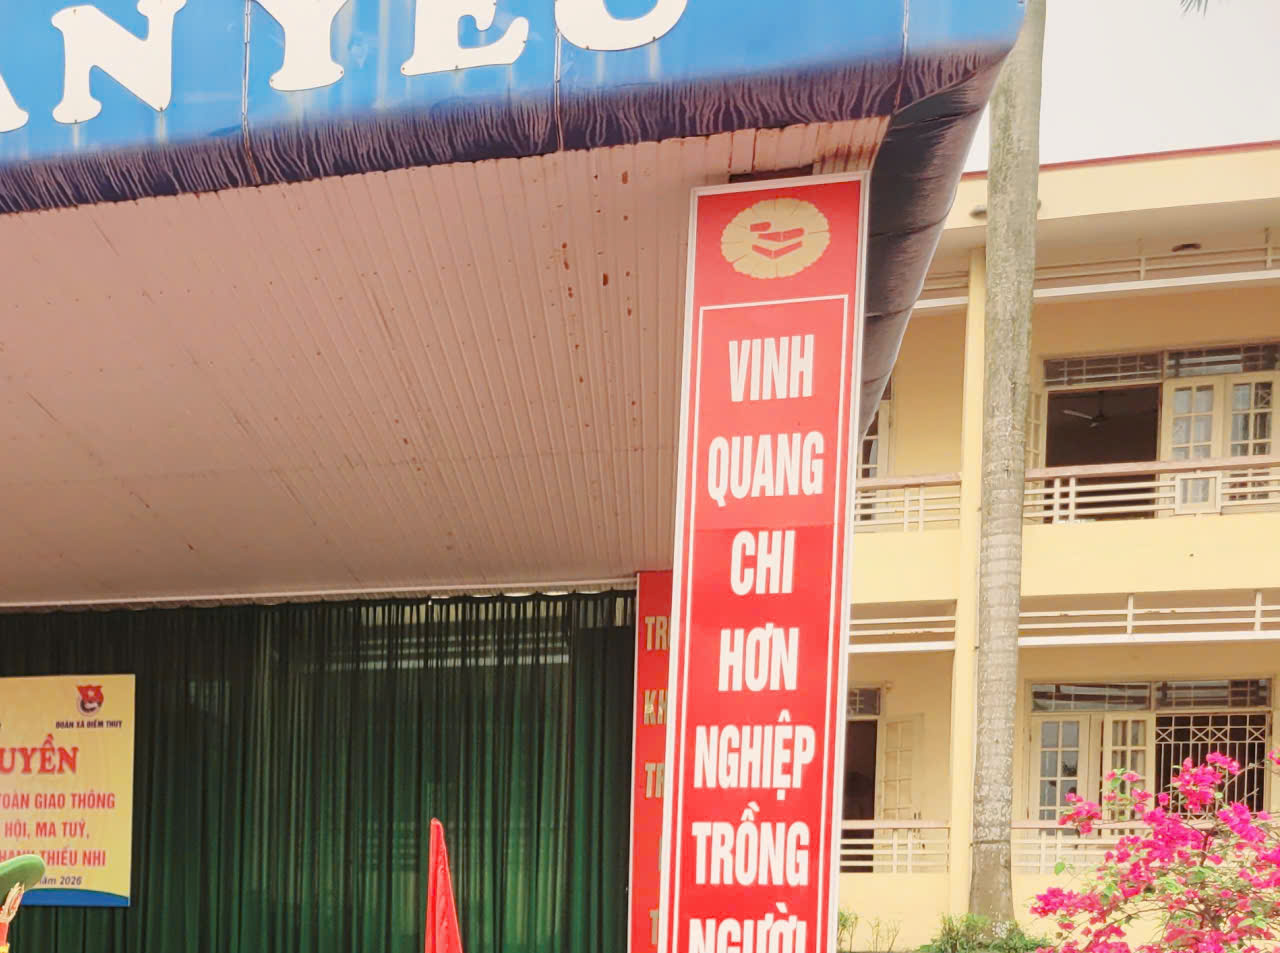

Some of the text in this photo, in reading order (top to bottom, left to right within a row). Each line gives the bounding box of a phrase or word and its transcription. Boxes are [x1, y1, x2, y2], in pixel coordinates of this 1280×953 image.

[728, 334, 815, 403] VINH
[707, 430, 825, 508] QUANG
[729, 530, 795, 597] CHI
[718, 621, 799, 693] HƠN
[693, 709, 817, 801] NGHIỆP
[34, 791, 67, 809] GIAO
[70, 789, 116, 809] THÔNG
[35, 821, 57, 838] MA
[82, 849, 107, 866] NHI
[692, 801, 809, 886] TRỒNG
[59, 876, 83, 886] 2026
